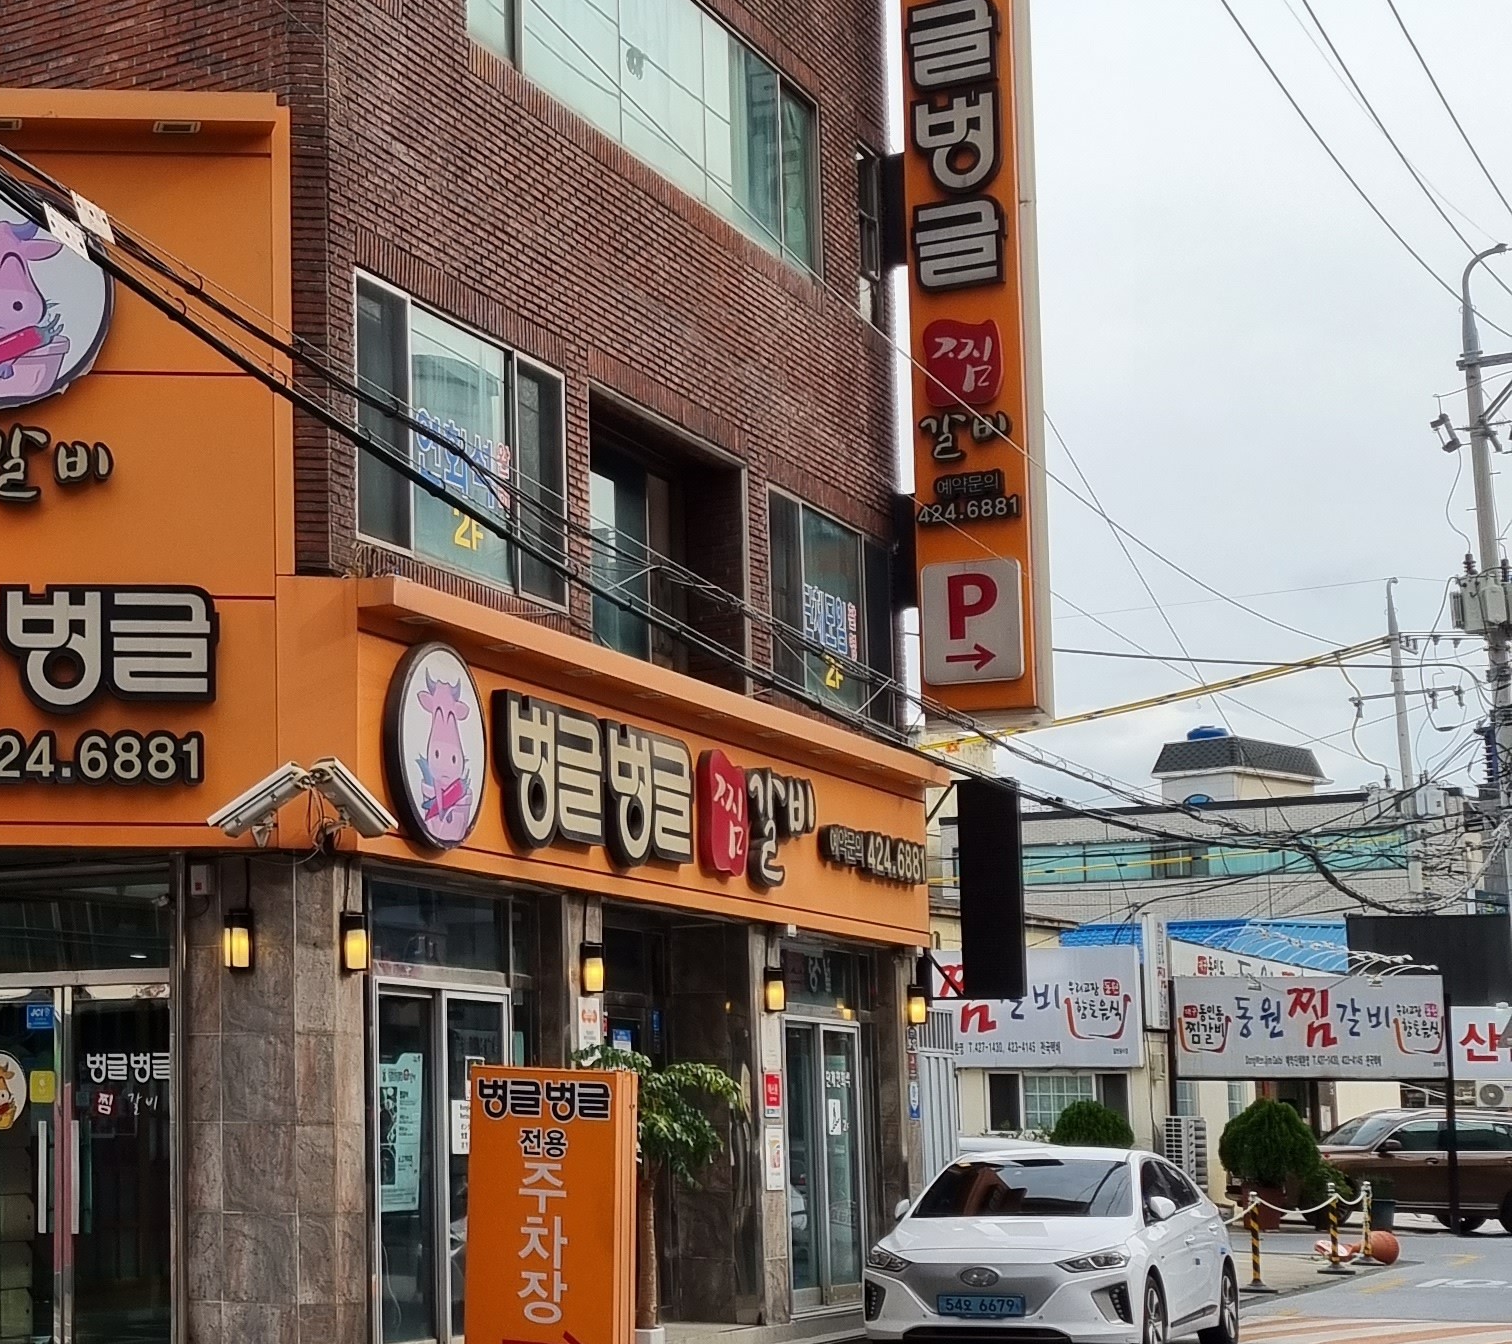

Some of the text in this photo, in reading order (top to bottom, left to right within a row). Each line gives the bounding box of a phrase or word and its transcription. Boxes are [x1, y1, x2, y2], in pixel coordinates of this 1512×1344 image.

[935, 471, 1000, 497] 예약문의
[917, 495, 1020, 525] 424.6881
[946, 572, 999, 641] P
[506, 698, 692, 862] 벙글벙글
[867, 834, 926, 882] 424.6881
[86, 1052, 170, 1083] 벙글벙글
[476, 1076, 612, 1122] 벙글벙글
[519, 1128, 569, 1158] 전용
[517, 1161, 569, 1326] 주차장
[979, 1299, 1015, 1312] 6679
